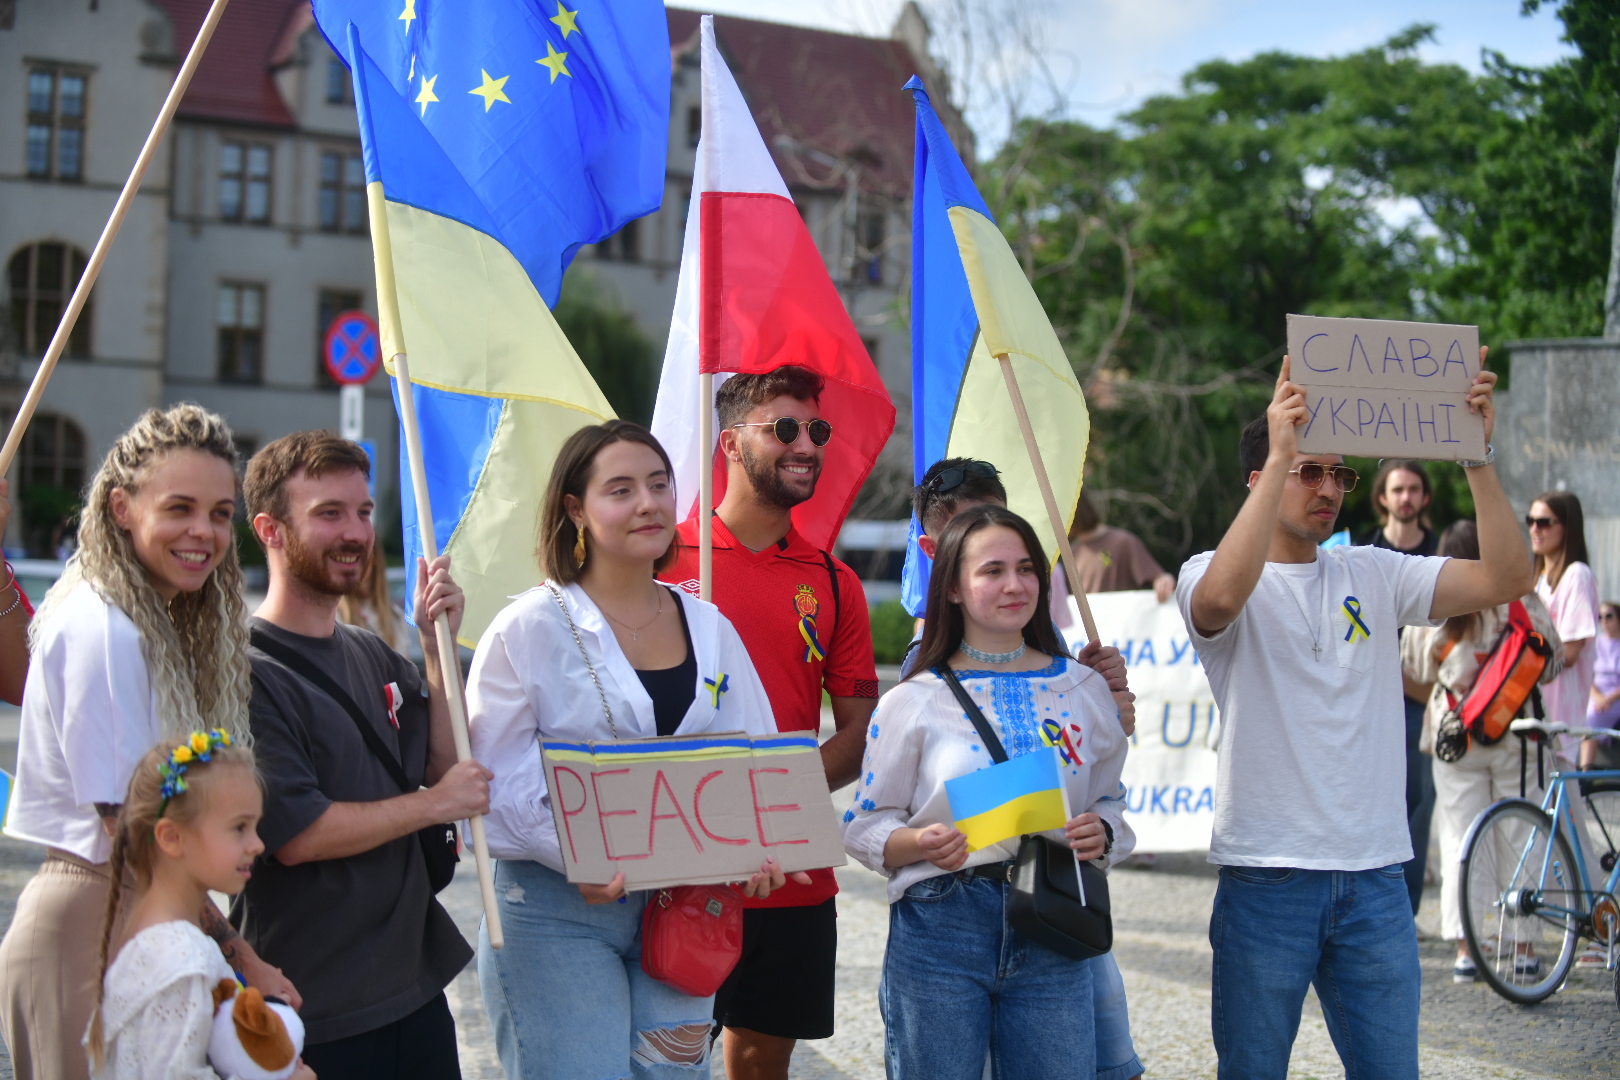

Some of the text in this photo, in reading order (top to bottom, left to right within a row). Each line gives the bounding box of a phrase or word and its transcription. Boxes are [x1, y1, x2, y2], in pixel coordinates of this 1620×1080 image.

[1302, 333, 1468, 378] СЛАВА
[1303, 396, 1461, 444] УКРАЇНІ
[553, 766, 810, 864] PEACE
